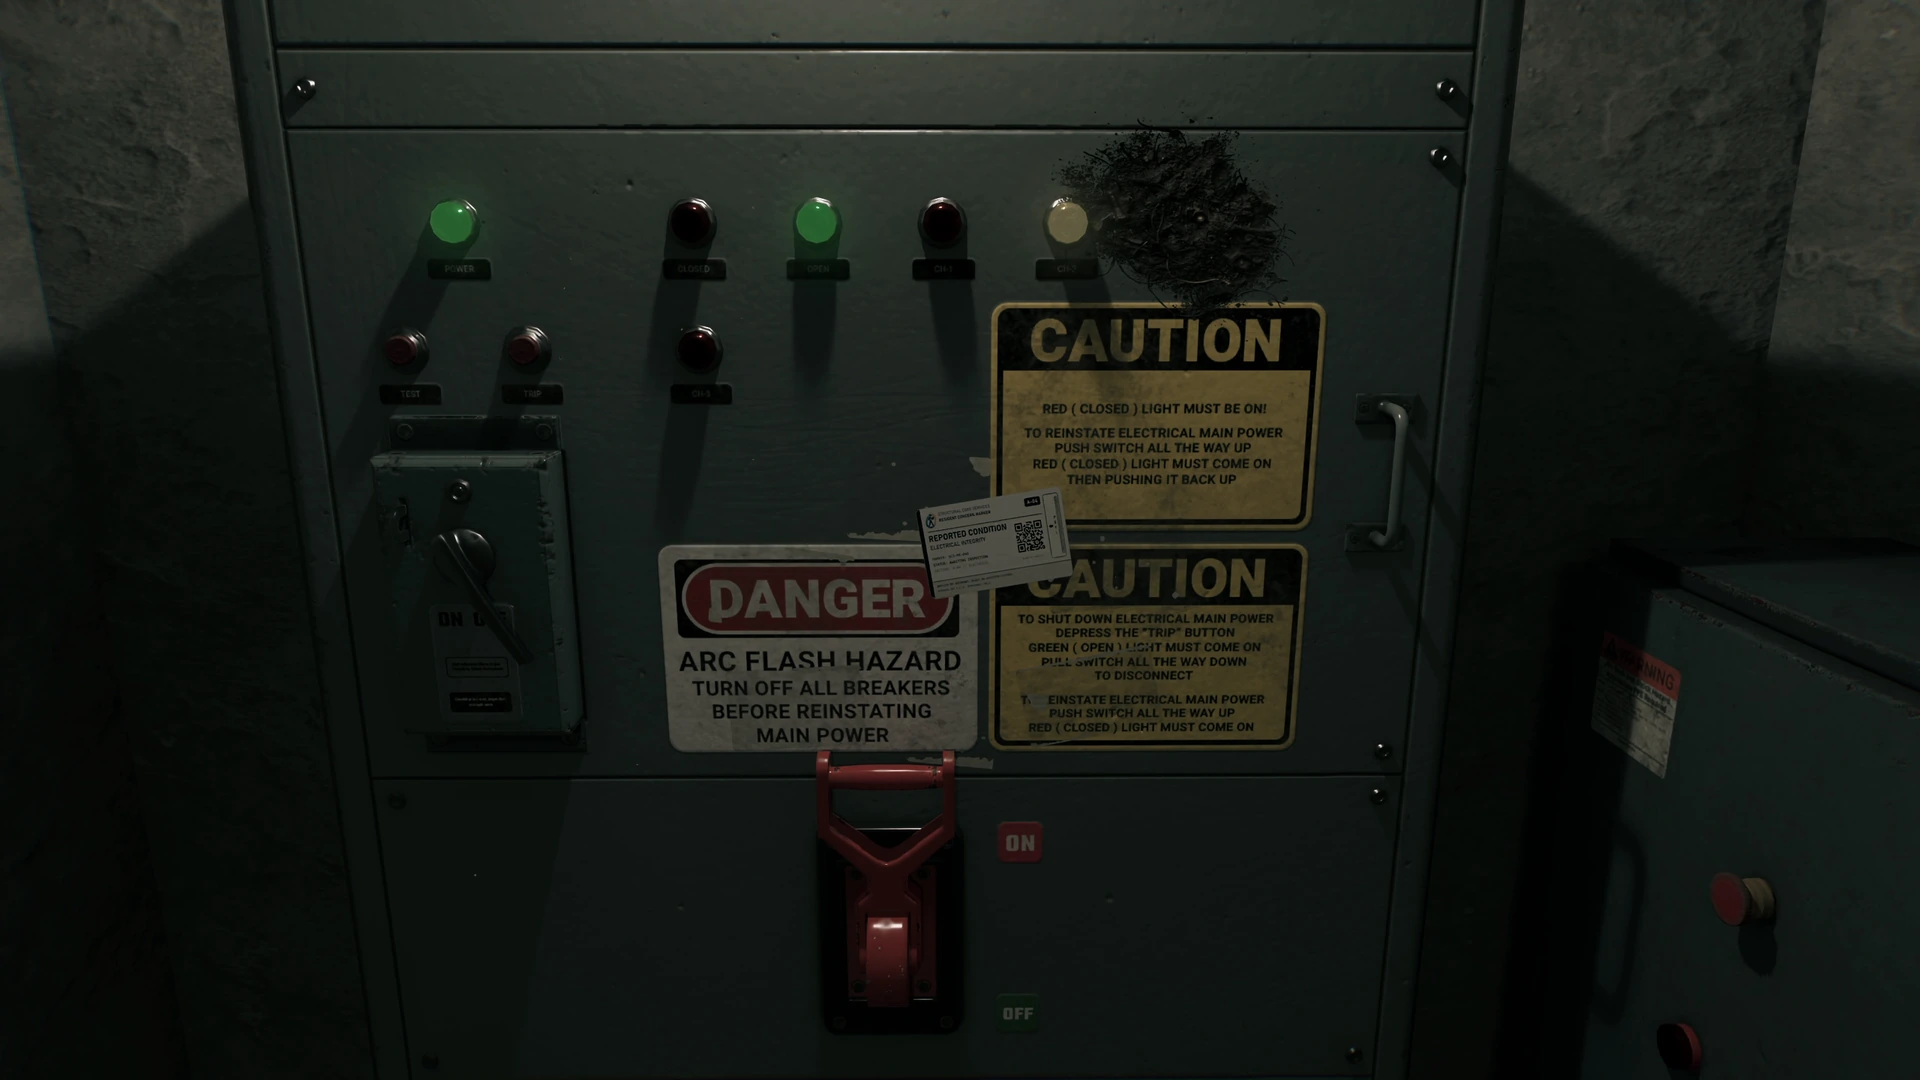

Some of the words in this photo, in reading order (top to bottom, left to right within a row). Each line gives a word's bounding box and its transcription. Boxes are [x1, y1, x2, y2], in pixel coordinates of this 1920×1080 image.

[444, 264, 475, 273] POWER
[677, 264, 711, 273] CLOSED
[807, 265, 830, 273] OPEN
[934, 264, 953, 273] CH-1
[1030, 317, 1283, 363] CAUTION
[400, 390, 421, 398] TEST
[523, 389, 543, 398] TRIP
[1042, 403, 1067, 415] RED
[1079, 403, 1130, 415] CLOSED
[1141, 403, 1180, 415] LIGHT
[1183, 403, 1221, 415] MUST
[1224, 403, 1241, 415] BE
[1243, 403, 1267, 415] ON!
[1024, 427, 1041, 439] TO
[1045, 427, 1116, 439] REINSTATE
[1118, 427, 1196, 439] ELECTRICAL
[1199, 427, 1234, 439] MAIN
[1237, 427, 1283, 439] POWER
[1054, 443, 1089, 454] PUSH
[1093, 443, 1144, 454] SWITCH
[1147, 443, 1171, 454] ALL
[1173, 443, 1200, 454] THE
[1203, 443, 1231, 454] WAY
[1234, 443, 1252, 454] UP
[1032, 458, 1058, 470] RED
[1069, 458, 1120, 470] CLOSED
[1131, 458, 1169, 470] LIGHT
[1172, 458, 1209, 470] MUST
[1212, 458, 1250, 470] COME
[1253, 458, 1272, 470] ON
[1067, 474, 1101, 485] THEN
[1104, 474, 1162, 485] PUSHING
[1166, 474, 1178, 485] IT
[1181, 474, 1216, 485] BACK
[1219, 474, 1237, 485] UP
[928, 529, 967, 543] REPORTED
[968, 523, 1007, 537] CONDITION
[930, 540, 961, 551] ELECTRICAL
[961, 536, 986, 546] INTEGRITY
[708, 578, 926, 624] DANGER
[438, 611, 463, 627] ON
[1018, 613, 1035, 624] TO
[1038, 613, 1072, 624] SHUT
[1074, 613, 1113, 624] DOWN
[1116, 613, 1191, 624] ELECTRICAL
[1193, 613, 1227, 624] MAIN
[1230, 613, 1274, 624] POWER
[1055, 627, 1111, 638] DEPRESS
[1114, 627, 1139, 638] THE
[1142, 627, 1182, 638] "TRIP"
[1185, 627, 1235, 638] BUTTON
[1028, 642, 1070, 653] GREEN
[1080, 642, 1115, 653] OPEN
[1165, 642, 1201, 653] MUST
[1204, 642, 1239, 653] COME
[1243, 642, 1261, 653] ON
[679, 651, 736, 672] ARC
[746, 651, 835, 672] FLASH
[847, 651, 961, 672] HAZARD
[1075, 656, 1124, 668] SWITCH
[1127, 656, 1150, 668] ALL
[1153, 656, 1178, 668] THE
[1180, 656, 1207, 668] WAY
[1209, 656, 1247, 668] DOWN
[1095, 670, 1111, 681] TO
[1114, 670, 1194, 681] DISCONNECT
[1620, 648, 1675, 691] WARNING
[692, 680, 748, 696] TURN
[755, 680, 793, 696] OFF
[800, 680, 837, 696] ALL
[843, 680, 951, 696] BREAKERS
[1047, 694, 1107, 705] EINSTATE
[1109, 694, 1183, 705] ELECTRICAL
[1185, 694, 1218, 705] MAIN
[1222, 694, 1265, 705] POWER
[712, 703, 791, 720] BEFORE
[797, 703, 932, 720] REINSTATING
[1049, 708, 1083, 718] PUSH
[1085, 708, 1134, 718] SWITCH
[1136, 708, 1160, 718] ALL
[1162, 708, 1188, 718] THE
[1190, 708, 1216, 718] WAY
[1218, 708, 1235, 718] UP
[1028, 721, 1052, 733] RED
[1063, 721, 1110, 733] CLOSED
[1121, 721, 1158, 733] LIGHT
[1160, 721, 1197, 733] MUST
[1199, 721, 1235, 733] COME
[1237, 721, 1254, 733] ON
[756, 727, 810, 743] MAIN
[817, 727, 889, 743] POWER
[1005, 834, 1035, 852] ON
[1002, 1007, 1035, 1021] OFF
